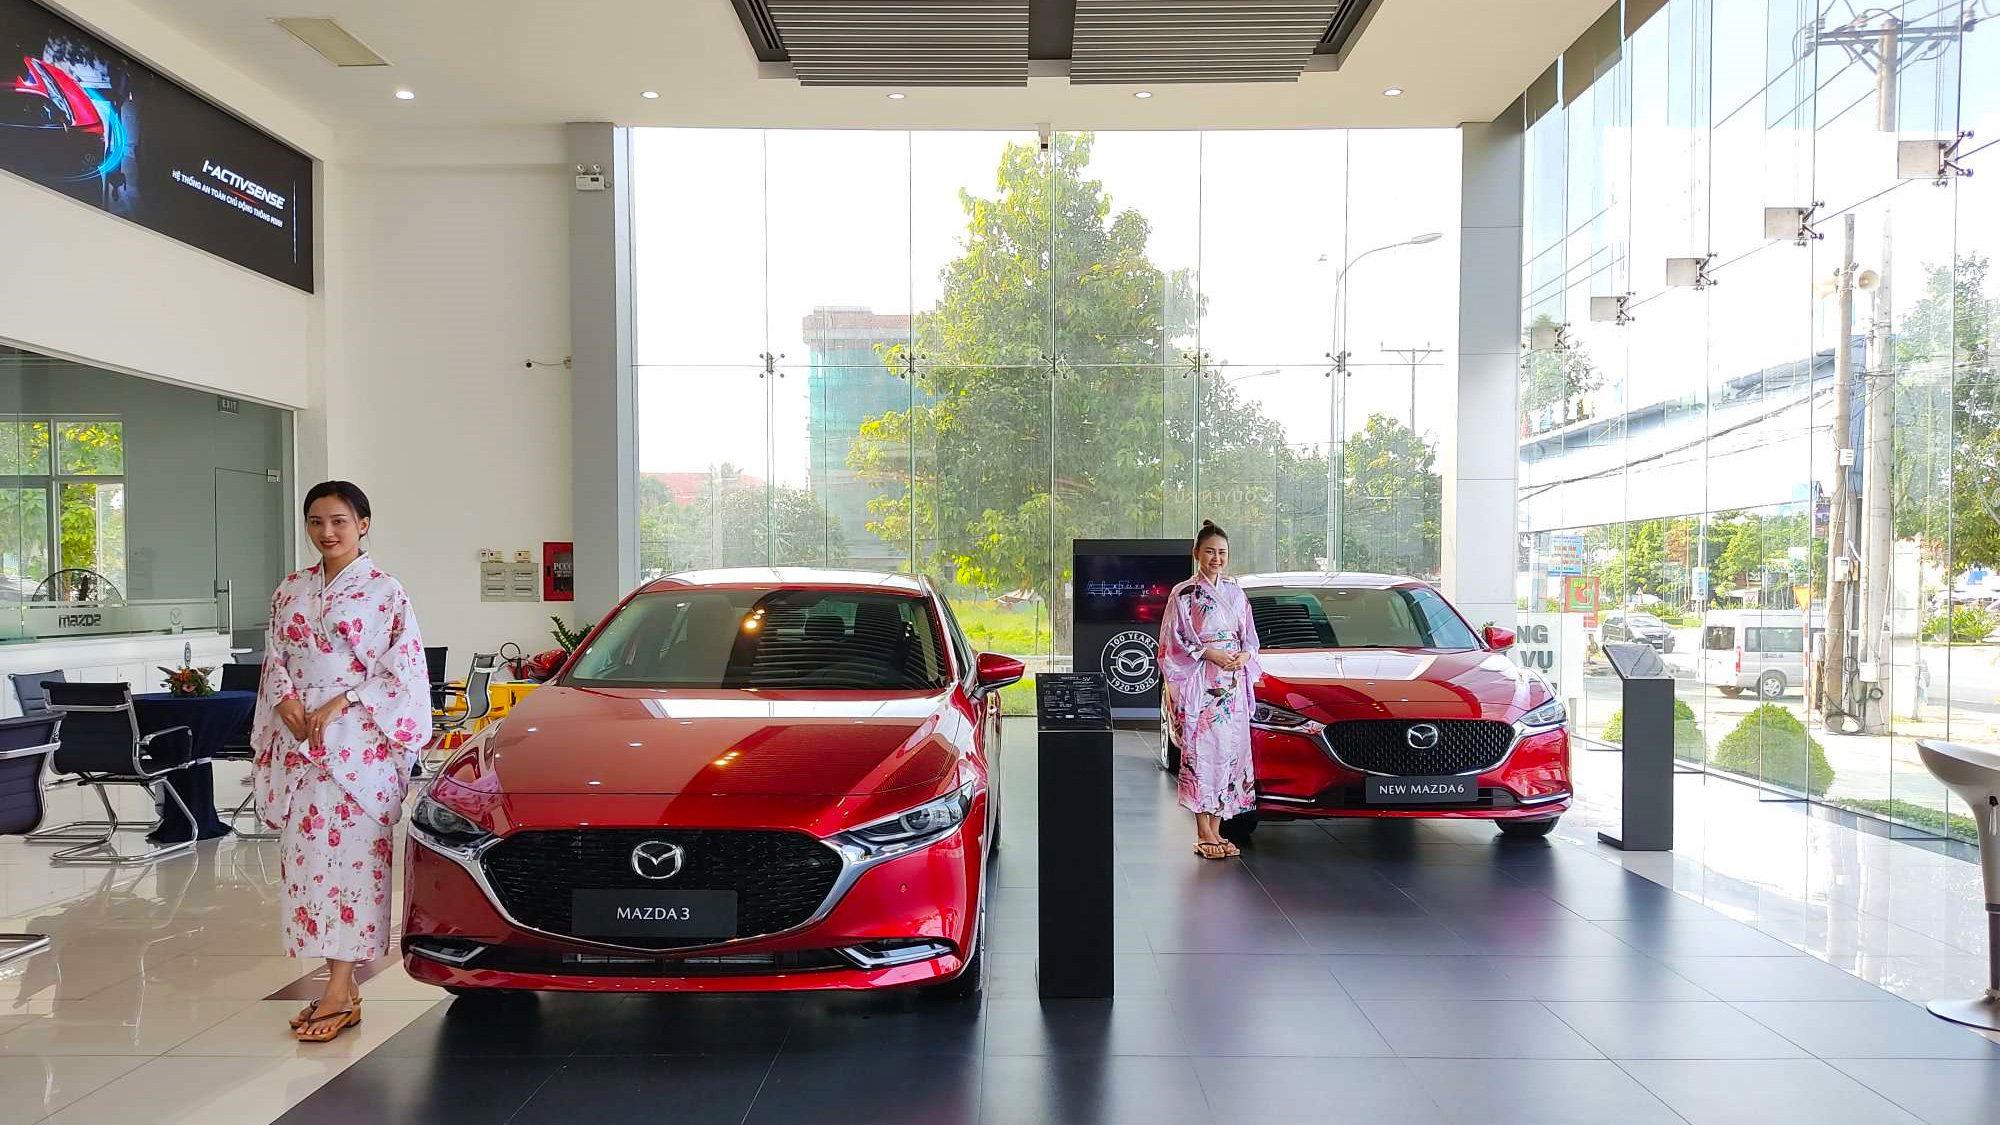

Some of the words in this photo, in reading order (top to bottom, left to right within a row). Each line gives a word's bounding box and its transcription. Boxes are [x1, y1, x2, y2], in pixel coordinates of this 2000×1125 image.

[201, 184, 210, 195] AN
[202, 160, 285, 209] I-ACTIVSENSE
[222, 398, 237, 411] EXIT
[1109, 635, 1125, 648] 100
[1128, 632, 1156, 649] YEARS
[1519, 650, 1554, 674] VỤ
[1109, 677, 1155, 692] 1920-2020
[1379, 784, 1407, 795] NEW
